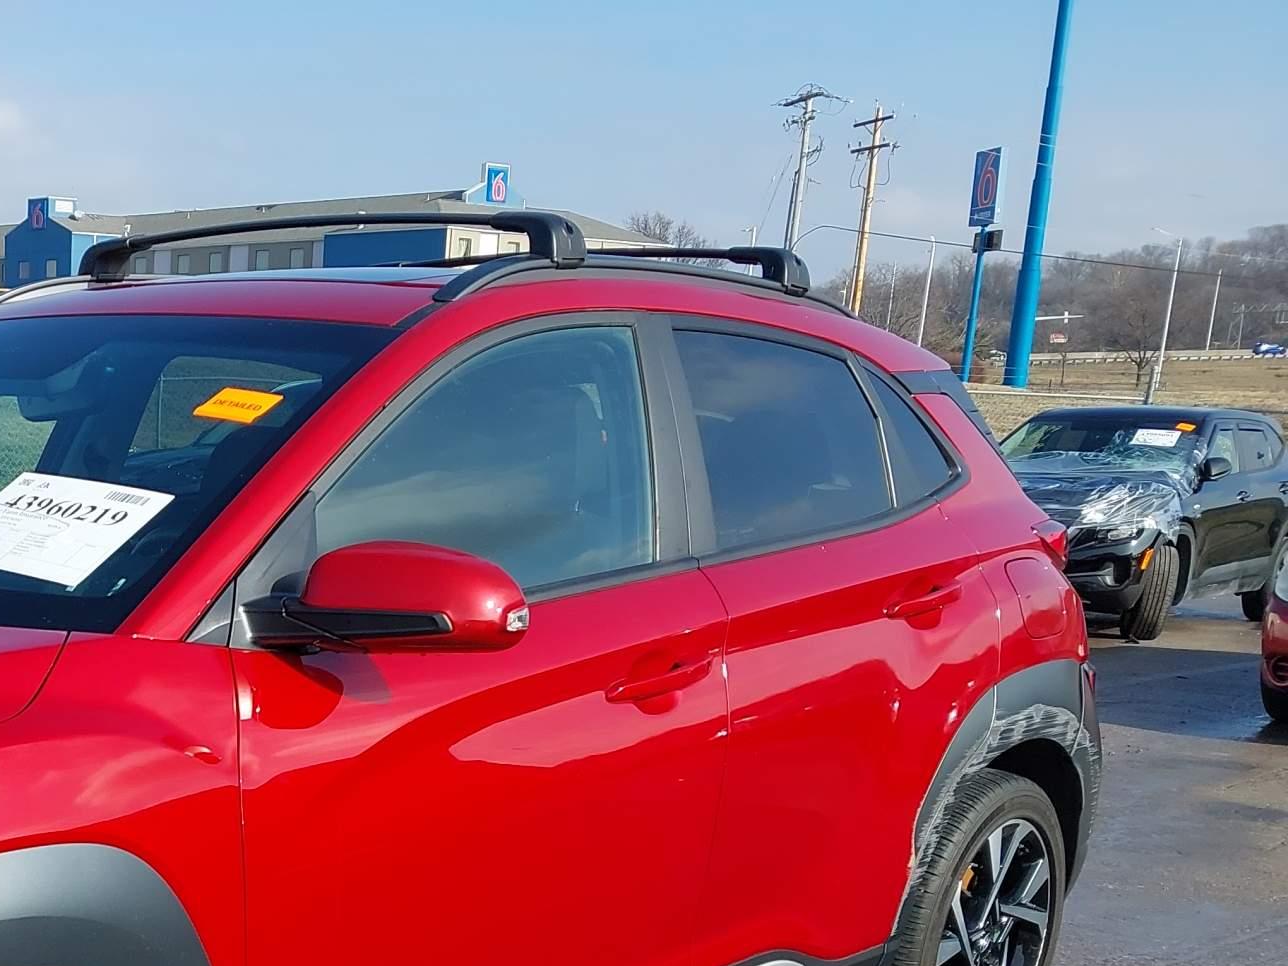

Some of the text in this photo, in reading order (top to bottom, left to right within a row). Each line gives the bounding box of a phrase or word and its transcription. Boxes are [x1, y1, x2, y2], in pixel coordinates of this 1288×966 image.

[491, 172, 505, 201] 6
[977, 151, 997, 209] 6
[32, 204, 44, 228] 6
[213, 399, 263, 411] DETAILED
[4, 494, 129, 526] 43960219
